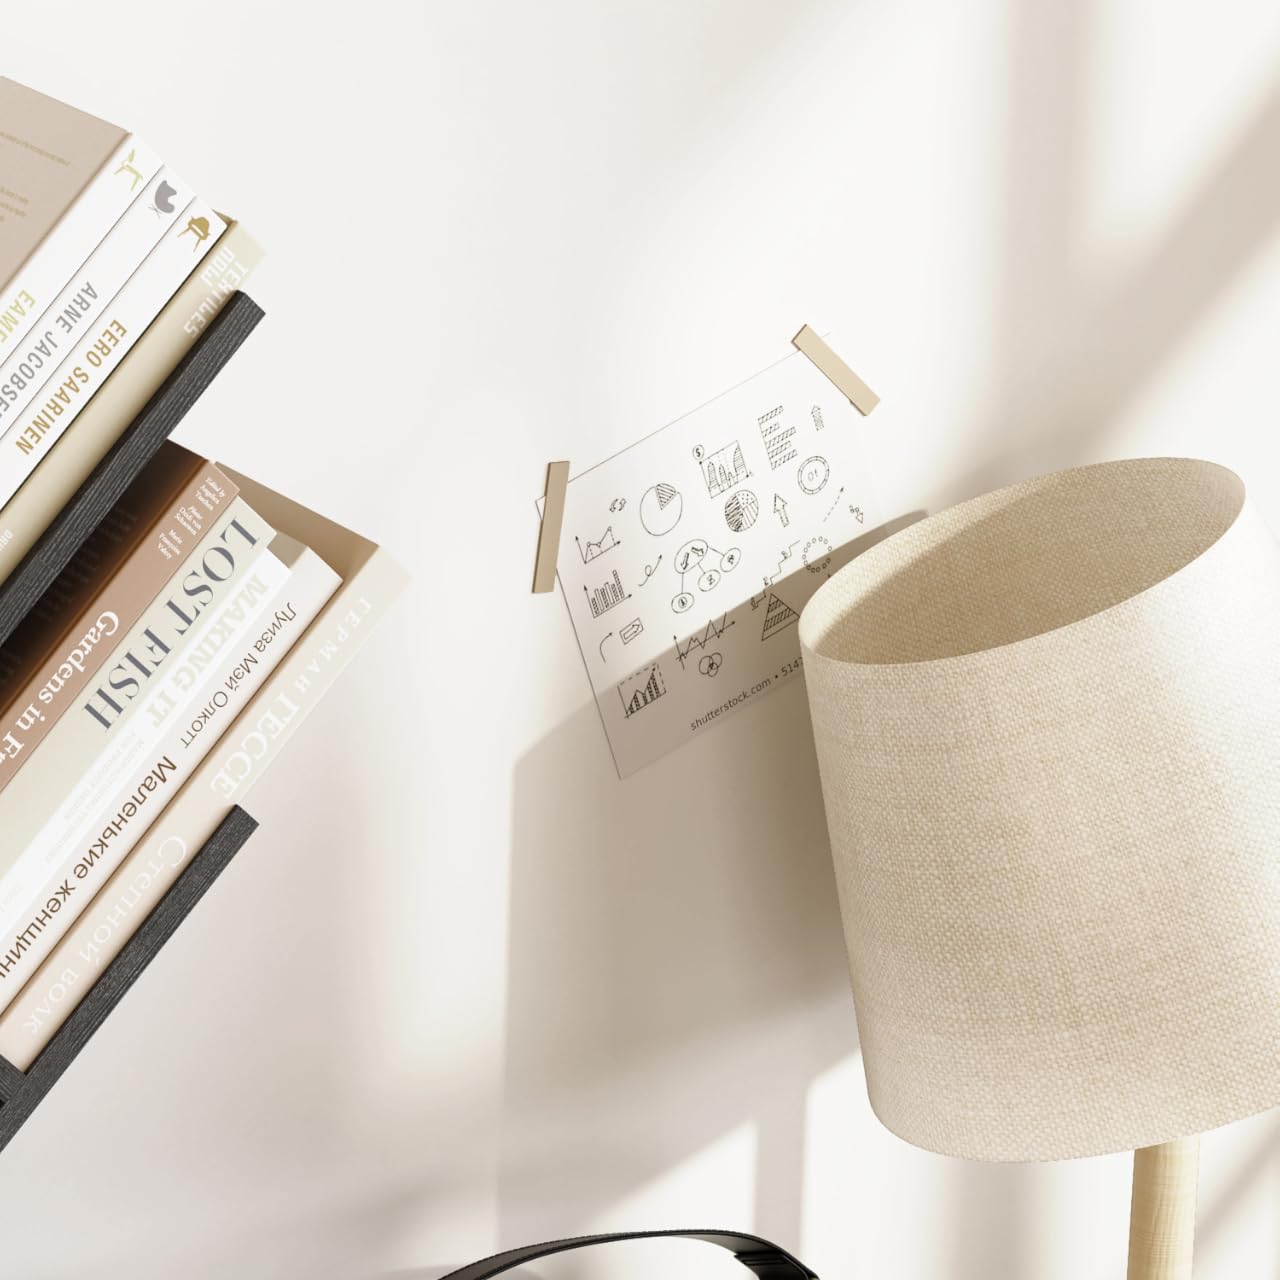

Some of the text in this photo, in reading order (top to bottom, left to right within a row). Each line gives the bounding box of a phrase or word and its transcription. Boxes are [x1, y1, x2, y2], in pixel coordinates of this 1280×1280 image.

[65, 281, 99, 333] ARNE
[16, 320, 128, 455] EERO SAARINEN
[164, 516, 259, 636] LOST
[173, 574, 268, 689] MAKING
[38, 610, 120, 705] Gardens
[82, 625, 173, 732] FISH
[179, 602, 297, 749] Луиза Мэй Олкотт
[690, 678, 772, 731] shutterstock.com
[15, 703, 46, 731] in
[72, 755, 178, 881] Маленькие
